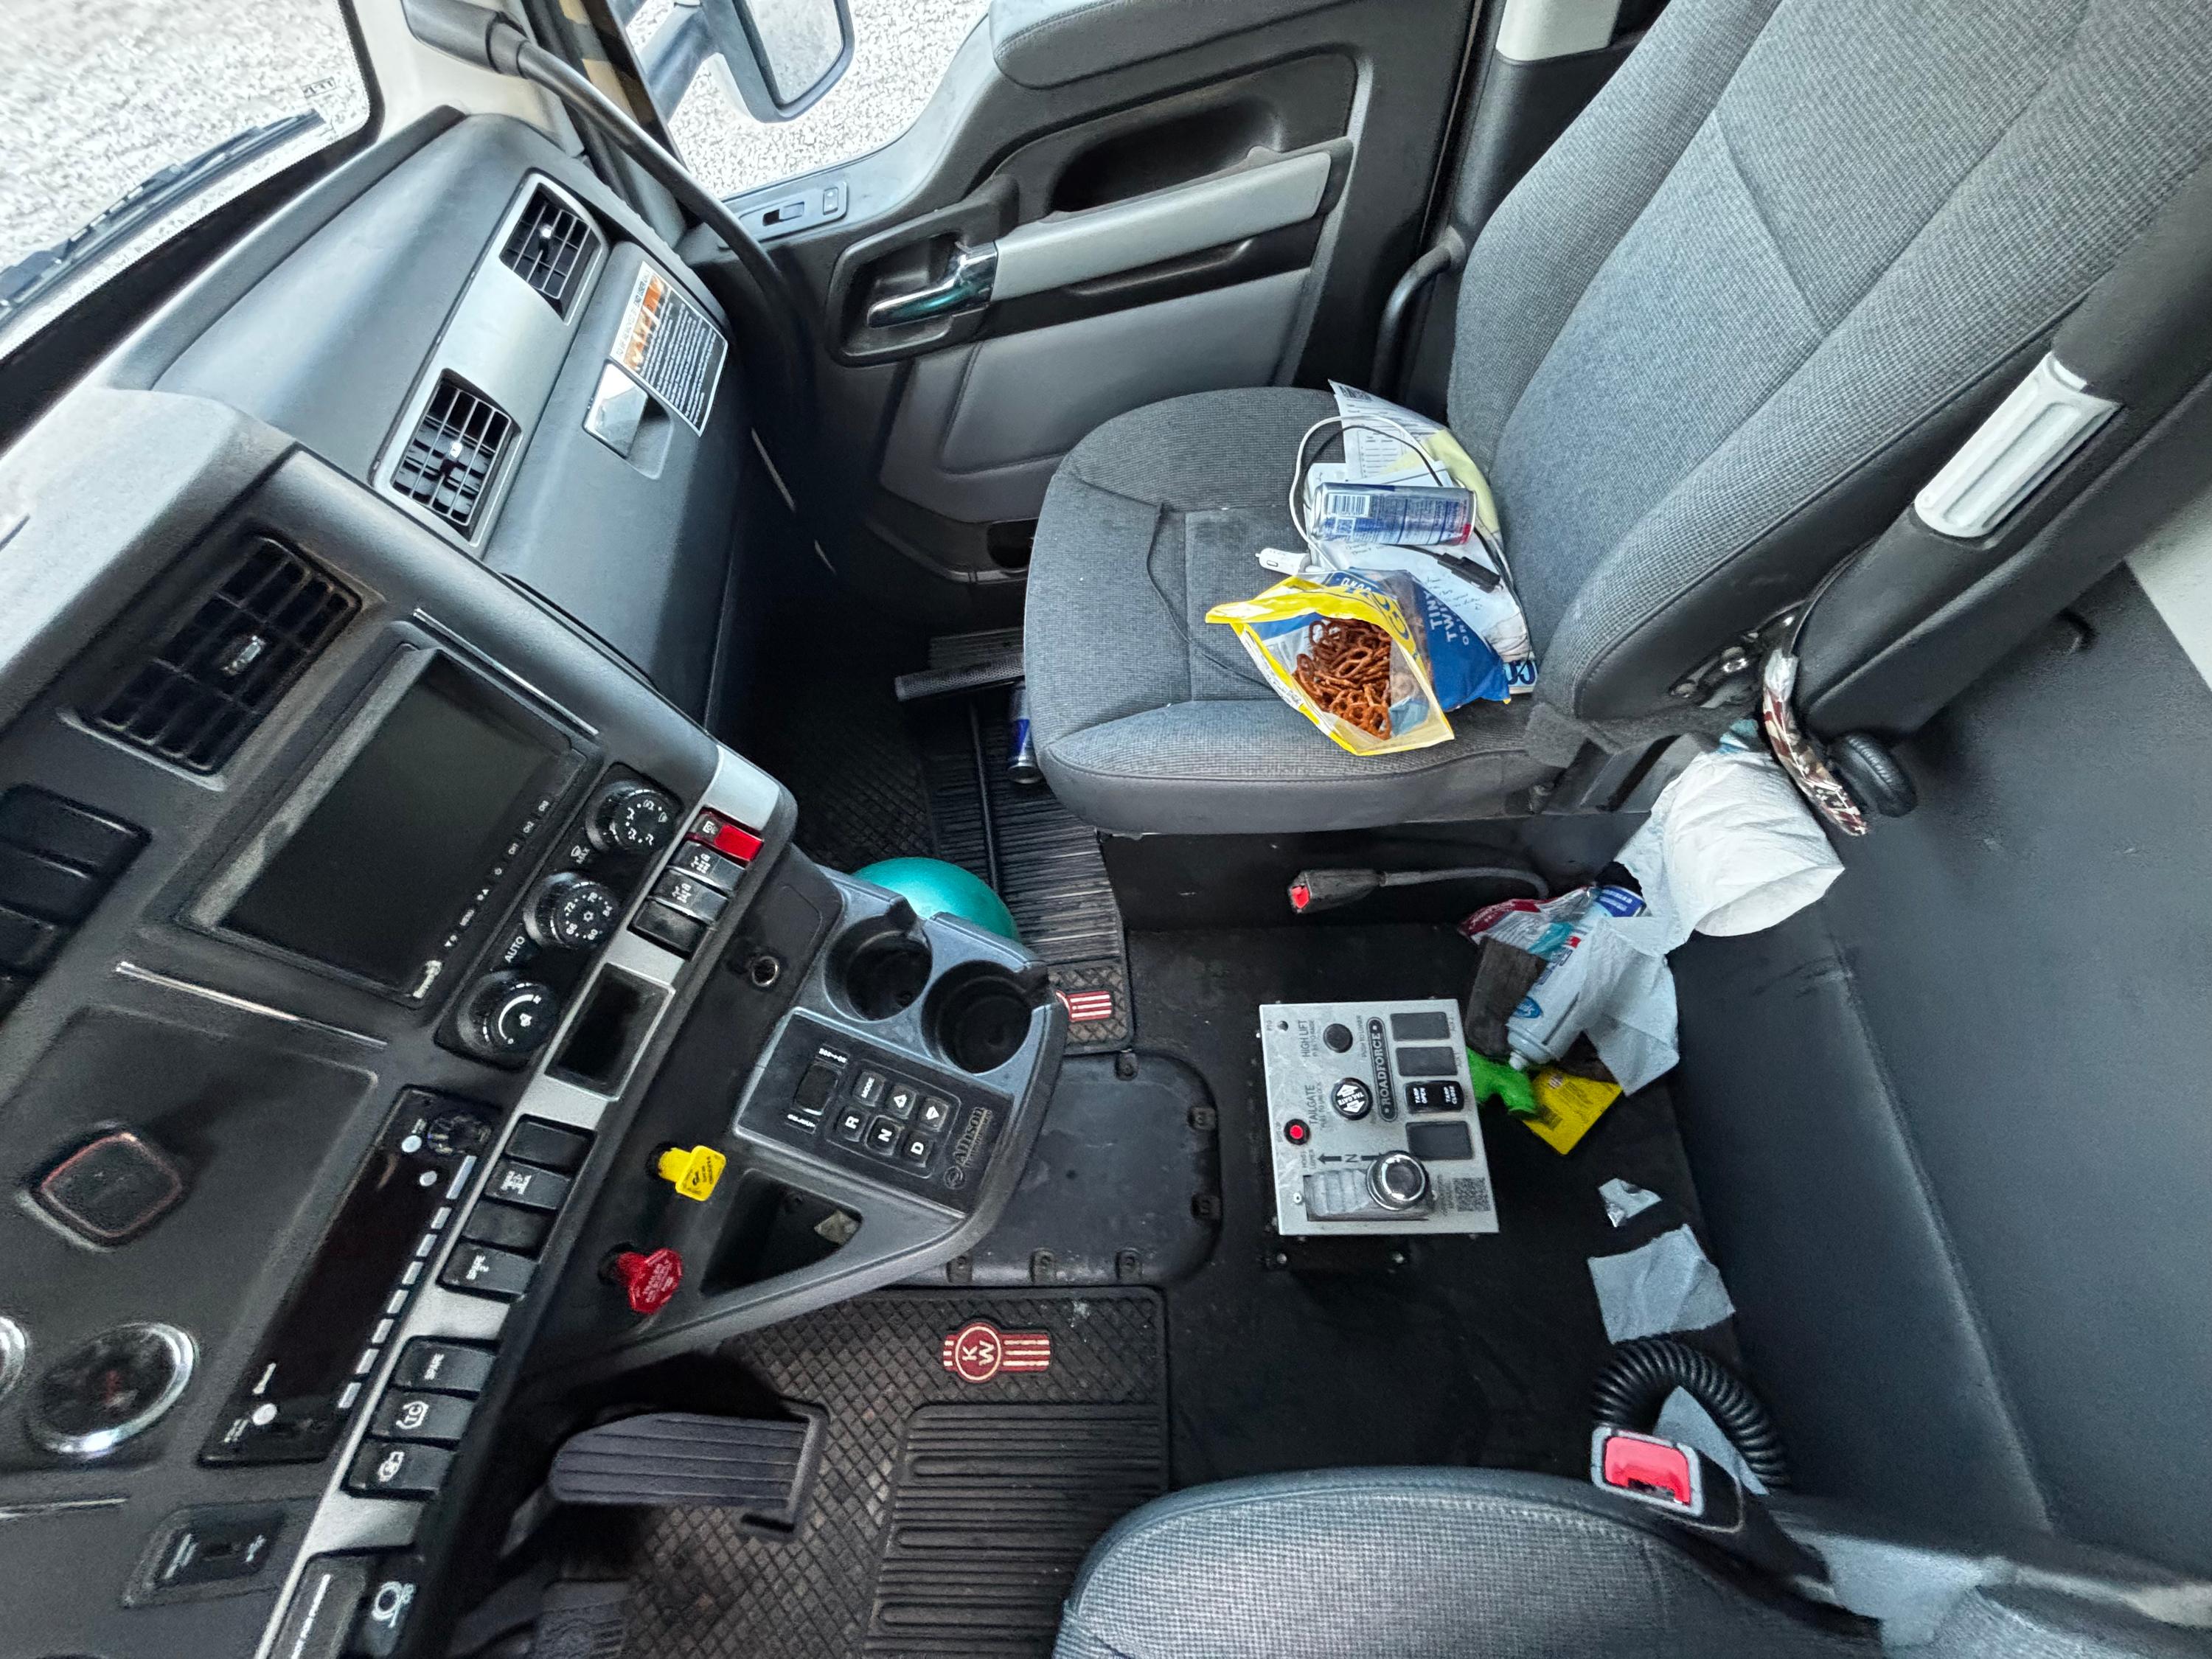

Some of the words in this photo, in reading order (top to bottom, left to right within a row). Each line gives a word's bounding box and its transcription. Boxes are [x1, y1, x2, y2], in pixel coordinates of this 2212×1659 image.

[1425, 591, 1444, 630] TINY
[576, 848, 590, 864] MAX
[564, 901, 576, 914] 72
[602, 905, 613, 917] 84
[588, 929, 599, 941] 60
[504, 936, 526, 963] AUTO
[1298, 1019, 1308, 1035] LIFT
[1300, 1037, 1310, 1057] HIGH
[1374, 1032, 1390, 1106] ROADFORCE
[861, 1077, 874, 1098] MODE
[1413, 1087, 1421, 1103] TARP
[1419, 1087, 1427, 1103] OPEN
[1449, 1085, 1457, 1104] CLOSE
[1305, 1083, 1318, 1124] TAILGATE
[845, 1116, 859, 1129] R
[878, 1129, 892, 1141] N
[953, 1107, 985, 1165] Allison
[911, 1141, 924, 1155] D
[1344, 1154, 1358, 1163] N
